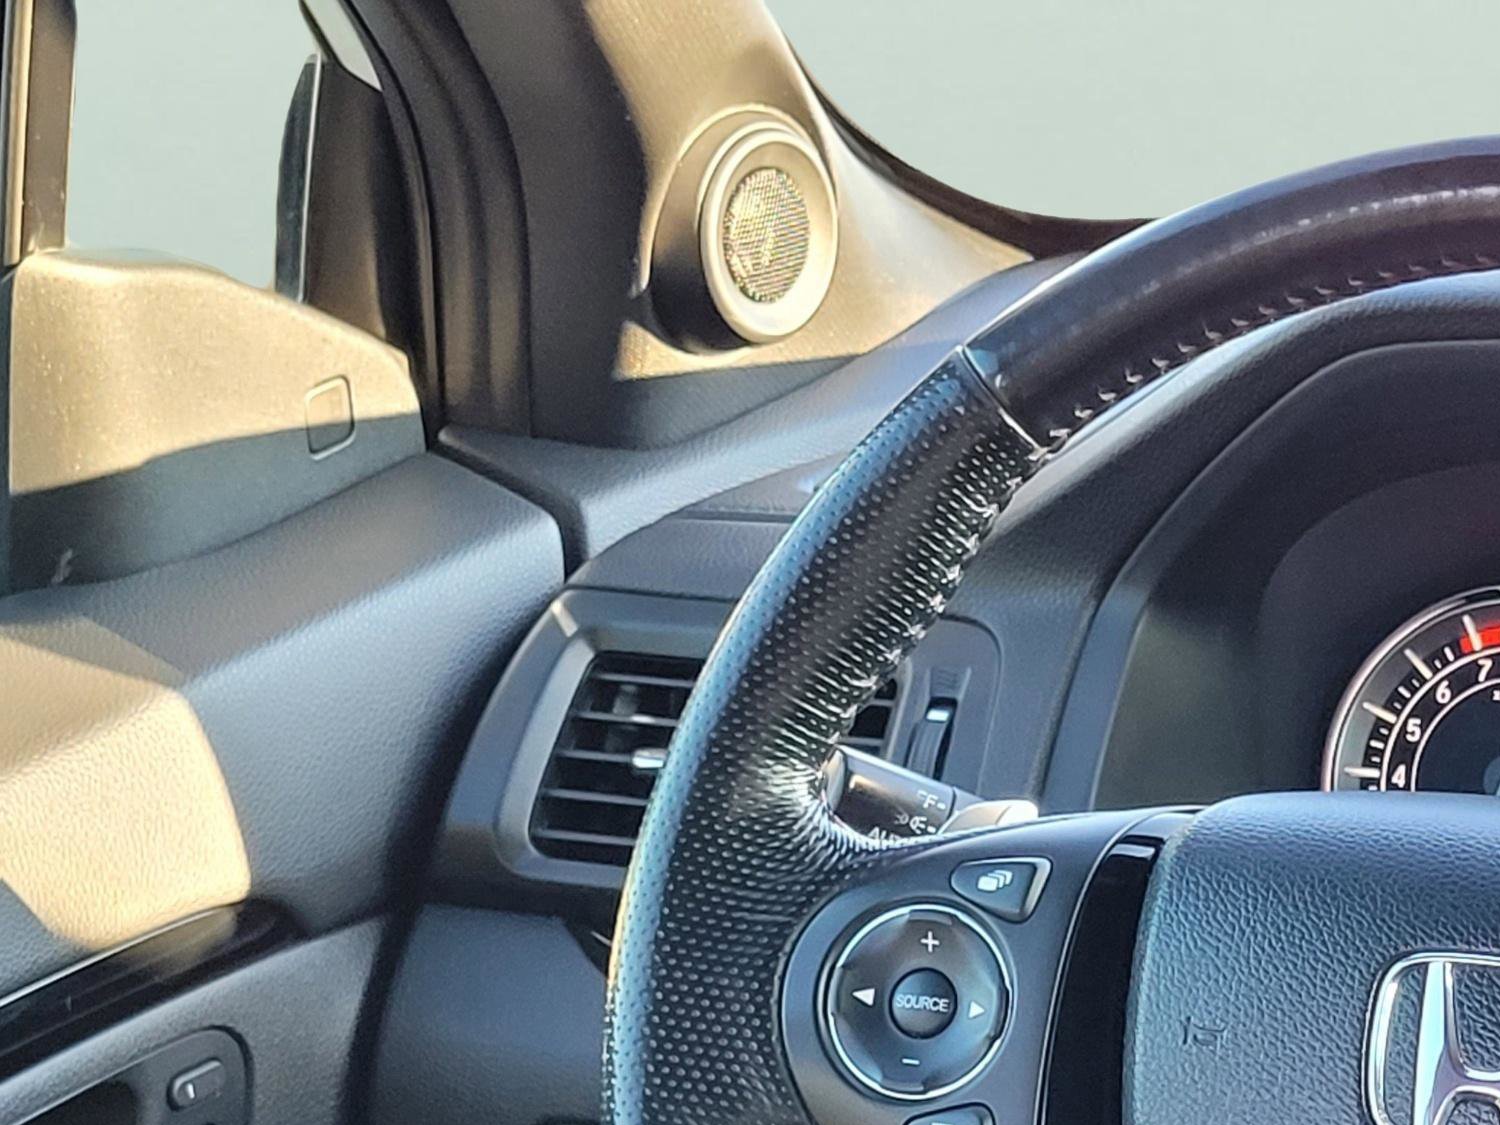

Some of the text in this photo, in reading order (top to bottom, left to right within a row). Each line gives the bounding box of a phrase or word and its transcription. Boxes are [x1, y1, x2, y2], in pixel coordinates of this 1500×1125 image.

[1477, 659, 1493, 682] 7
[1436, 680, 1451, 704] 6
[1405, 718, 1422, 742] 5
[1391, 764, 1406, 788] 4
[896, 993, 949, 1013] SOURCE
